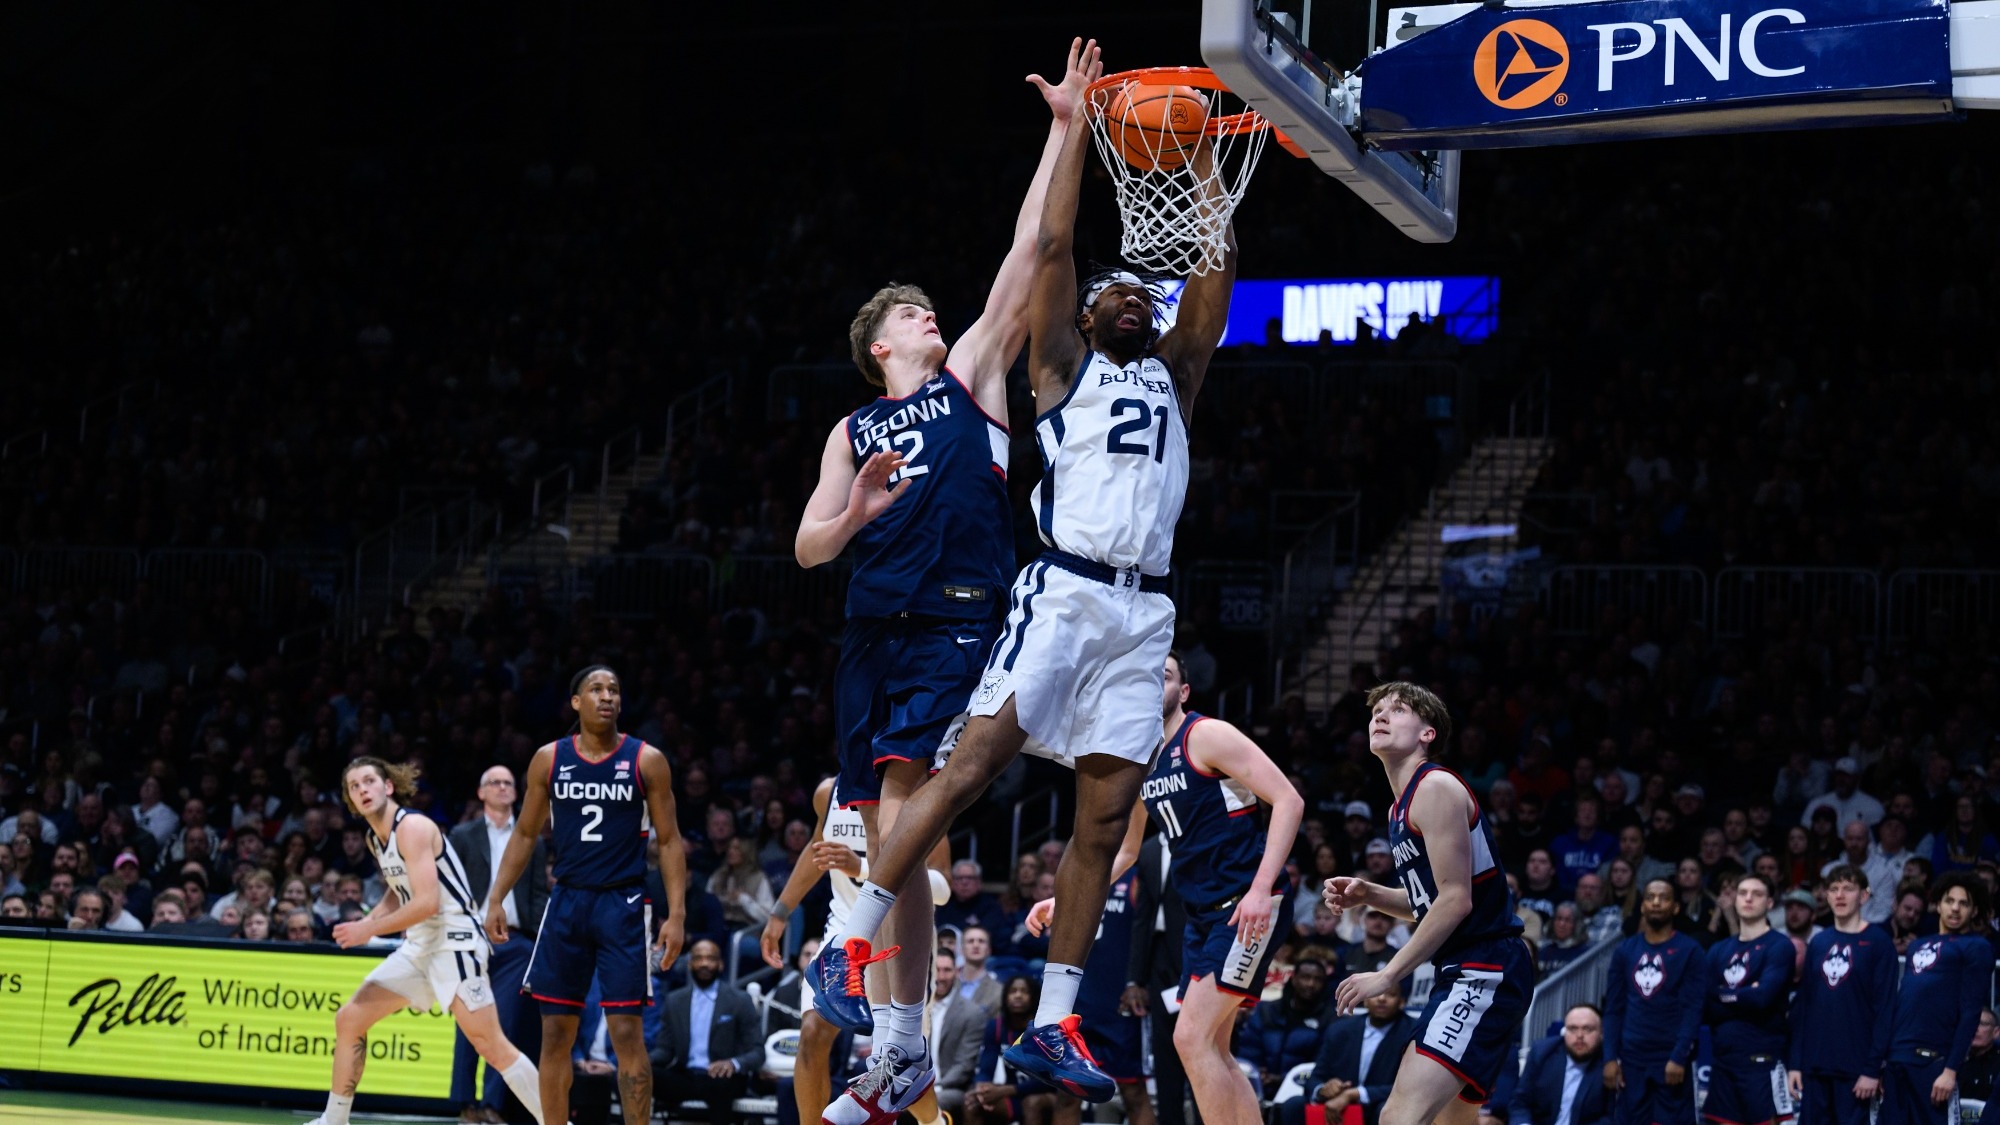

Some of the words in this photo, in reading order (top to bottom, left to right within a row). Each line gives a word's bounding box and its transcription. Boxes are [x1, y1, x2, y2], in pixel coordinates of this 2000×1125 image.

[1587, 8, 1806, 92] PNC
[854, 396, 951, 457] UCONN
[1107, 398, 1168, 464] 21
[877, 430, 929, 483] 12
[554, 782, 633, 802] UCONN
[1140, 772, 1188, 801] UCONN
[581, 805, 603, 841] 2
[832, 824, 866, 838] BUTL
[1157, 799, 1183, 839] 11
[1233, 936, 1262, 982] HUS
[0, 973, 22, 993] rs
[203, 978, 342, 1012] Windows
[68, 973, 187, 1048] Pella
[198, 1022, 229, 1050] of
[237, 1024, 422, 1062] Indianolis
